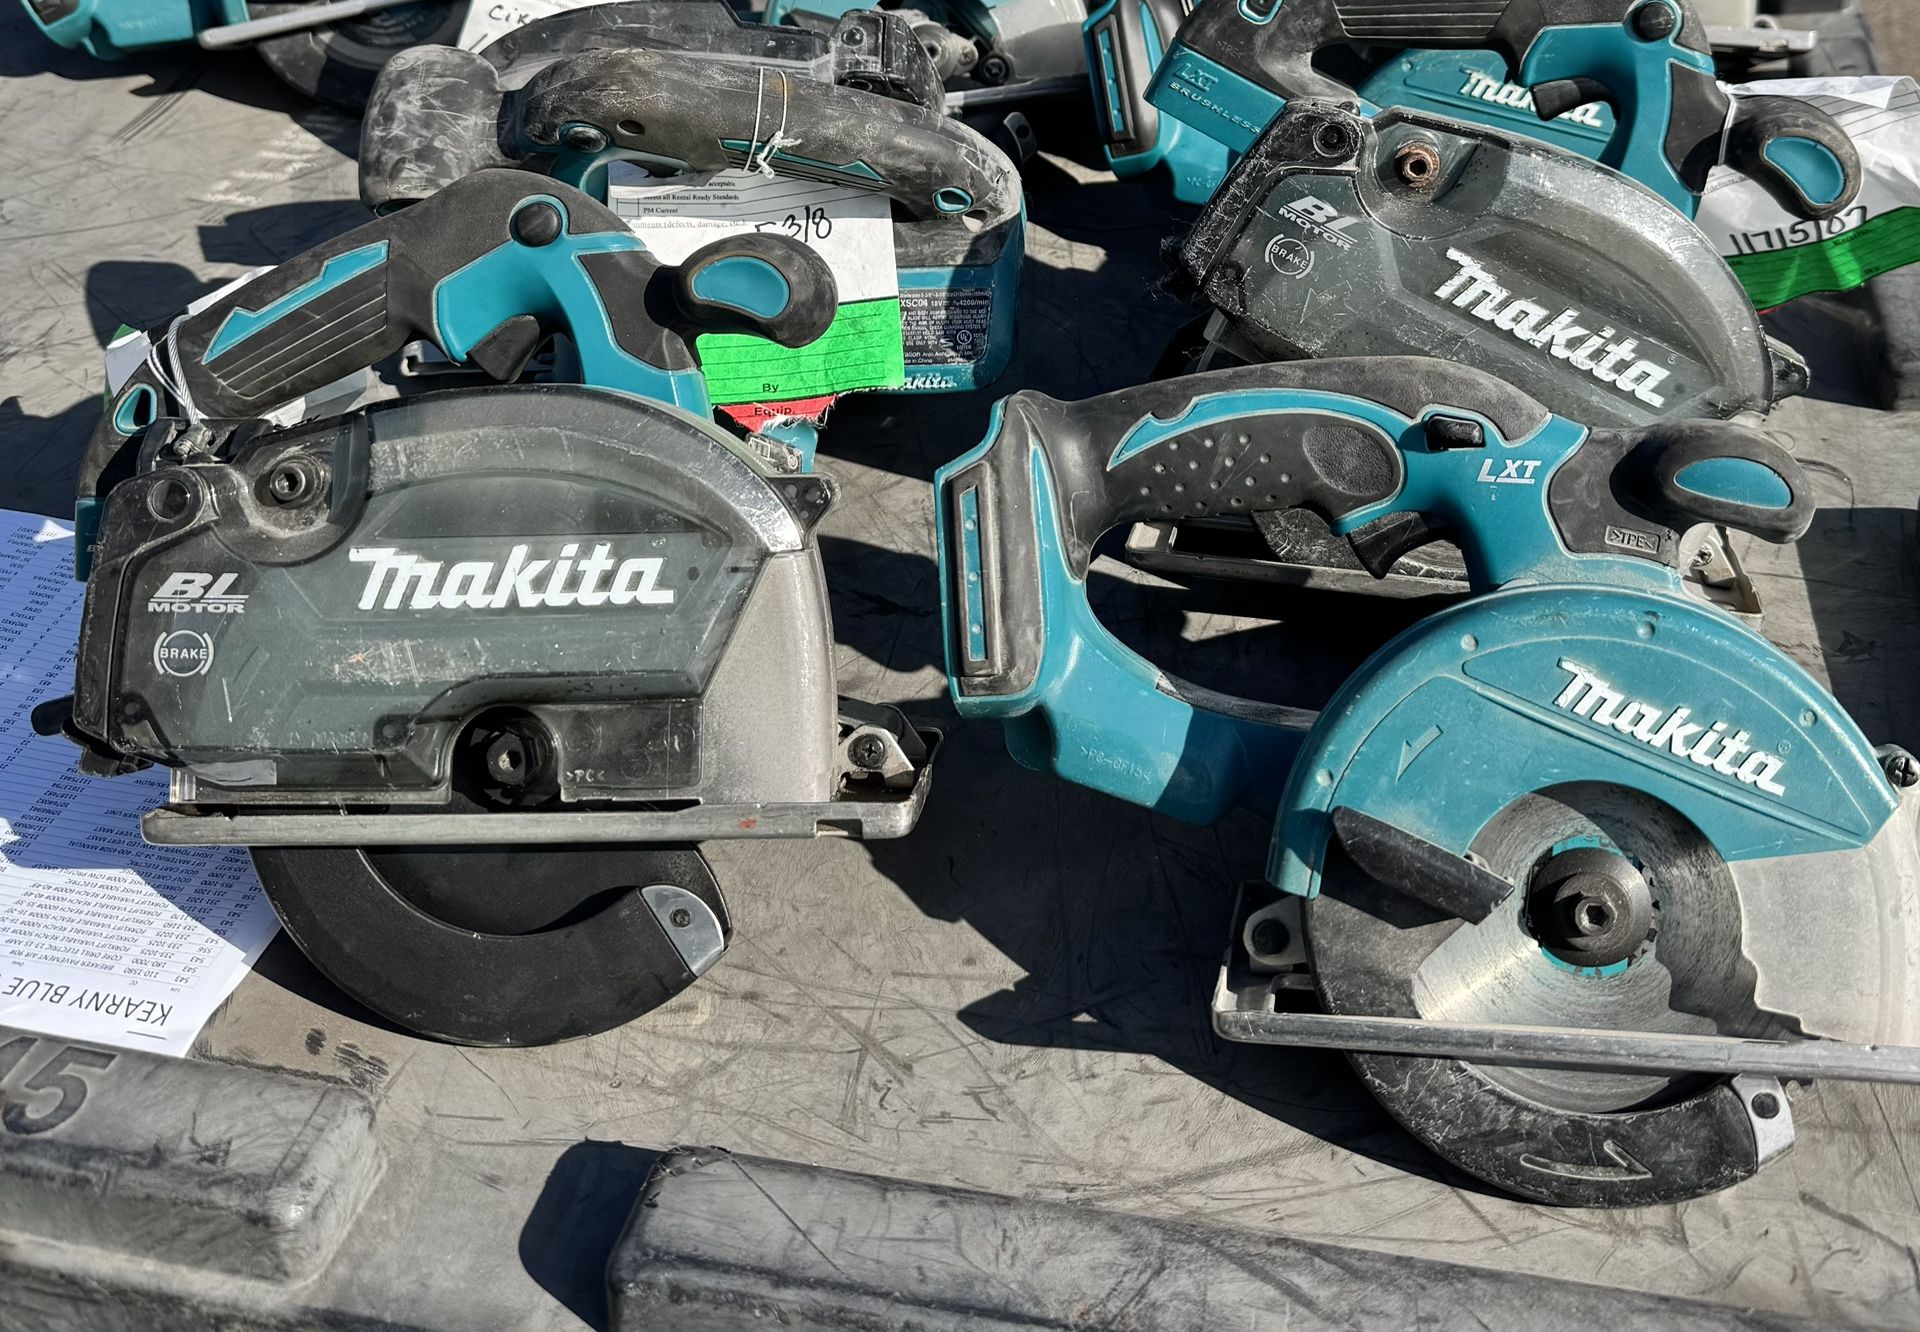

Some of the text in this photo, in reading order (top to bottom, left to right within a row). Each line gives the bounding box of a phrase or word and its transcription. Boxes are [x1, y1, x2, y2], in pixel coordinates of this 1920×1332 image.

[1169, 81, 1262, 135] BRUSHLESS
[692, 194, 712, 202] Ready
[712, 193, 740, 201] Standards
[1285, 195, 1360, 243] BL
[663, 221, 696, 230] (defects,
[1279, 207, 1351, 251] MOTOR
[1271, 244, 1308, 270] BRAKE
[900, 298, 928, 308] XSC04
[762, 382, 780, 393] By
[1476, 458, 1542, 484] LXT
[32, 576, 67, 584] FURUKAWA
[152, 572, 250, 599] BL
[27, 591, 54, 599] SNORKEL
[148, 602, 246, 613] MOTOR
[9, 612, 35, 620] SKYJACK
[0, 618, 28, 627] SNORKEL
[160, 648, 208, 659] BRAKE
[68, 840, 99, 849] MANUAL
[155, 854, 191, 864] MATERIAL
[125, 860, 159, 868] ELECTRIC
[119, 868, 153, 877] ELECTRIC
[64, 878, 98, 887] ELECTRIC
[152, 881, 185, 890] FORKLIFT
[100, 893, 136, 902] VARIABLE
[144, 890, 178, 898] FORKLIFT
[93, 901, 128, 910] VARIABLE
[136, 898, 170, 907] FORKLIFT
[84, 910, 120, 919] VARIABLE
[128, 906, 162, 915] FORKLIFT
[76, 918, 112, 928] VARIABLE
[120, 915, 155, 924] FORKLIFT
[68, 927, 104, 936] VARIABLE
[112, 924, 147, 933] FORKLIFT
[103, 932, 138, 942] FORKLIFT
[155, 930, 189, 939] 233-1025
[60, 936, 96, 945] VARIABLE
[147, 939, 182, 948] 233-1025
[44, 944, 79, 953] ELECTRIC
[95, 941, 130, 951] FORKLIFT
[139, 948, 174, 958] 233-1025
[36, 953, 80, 964] PAVEMENT
[79, 960, 114, 970] BREAKER
[122, 967, 159, 977] 110-1580
[2, 976, 173, 1026] KEARNY BLUE
